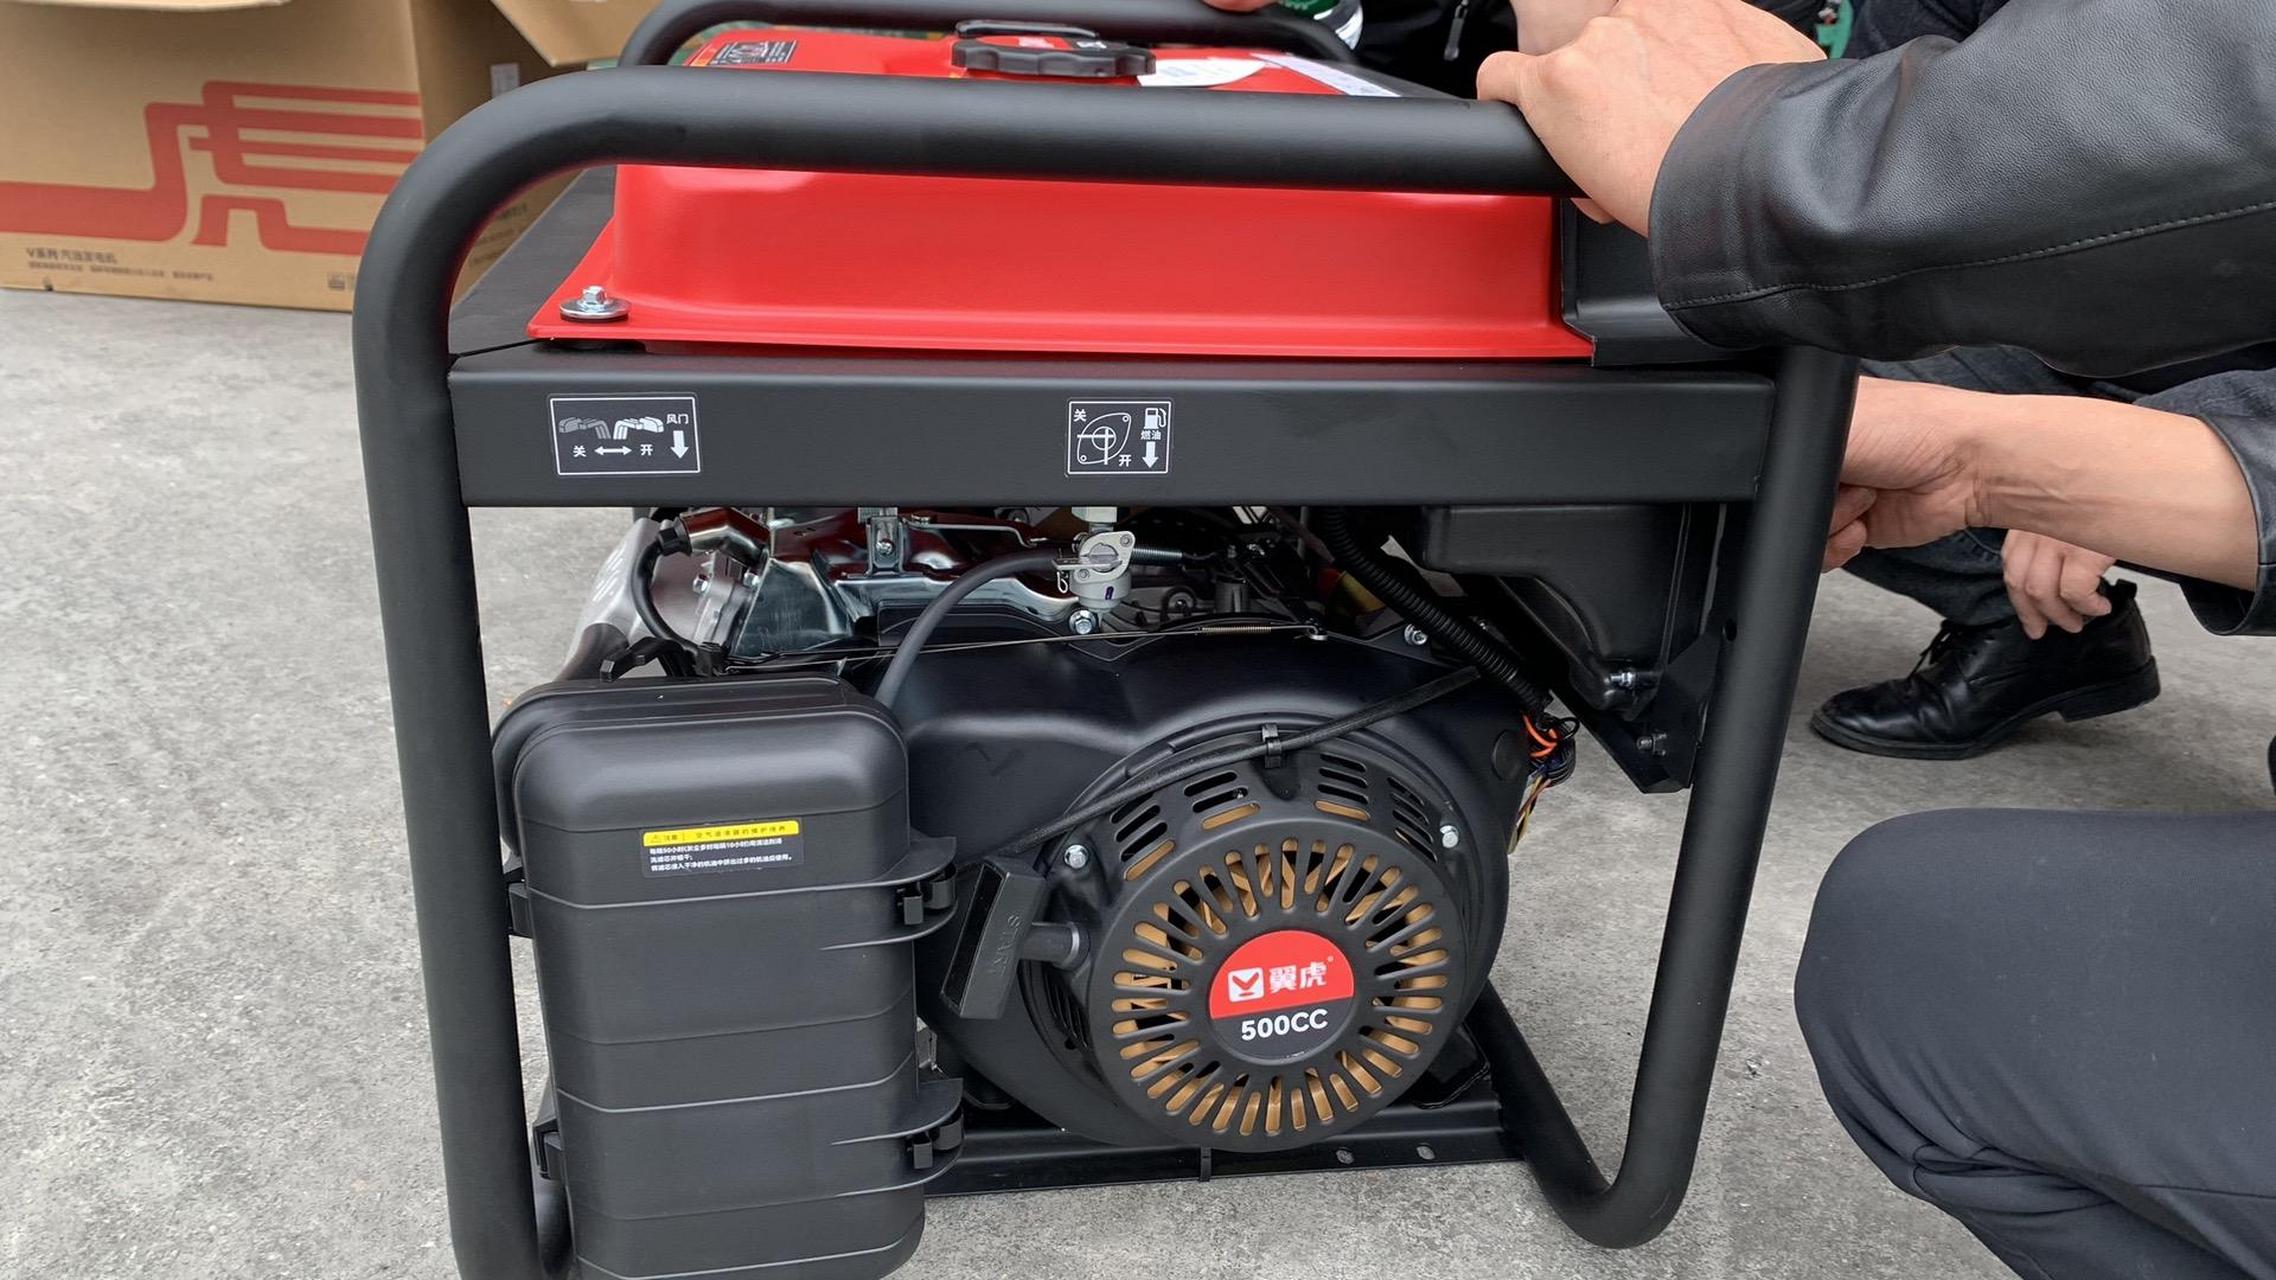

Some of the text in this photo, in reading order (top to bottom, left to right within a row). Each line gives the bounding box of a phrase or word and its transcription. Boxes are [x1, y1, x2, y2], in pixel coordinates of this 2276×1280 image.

[666, 413, 689, 425] 风门
[1073, 408, 1087, 422] 关
[1140, 430, 1162, 440] 燃油
[573, 445, 587, 458] 关
[640, 444, 654, 456] 开
[1118, 454, 1132, 467] 开
[1269, 962, 1327, 993] 翼虎
[1241, 1008, 1329, 1041] 500CC
